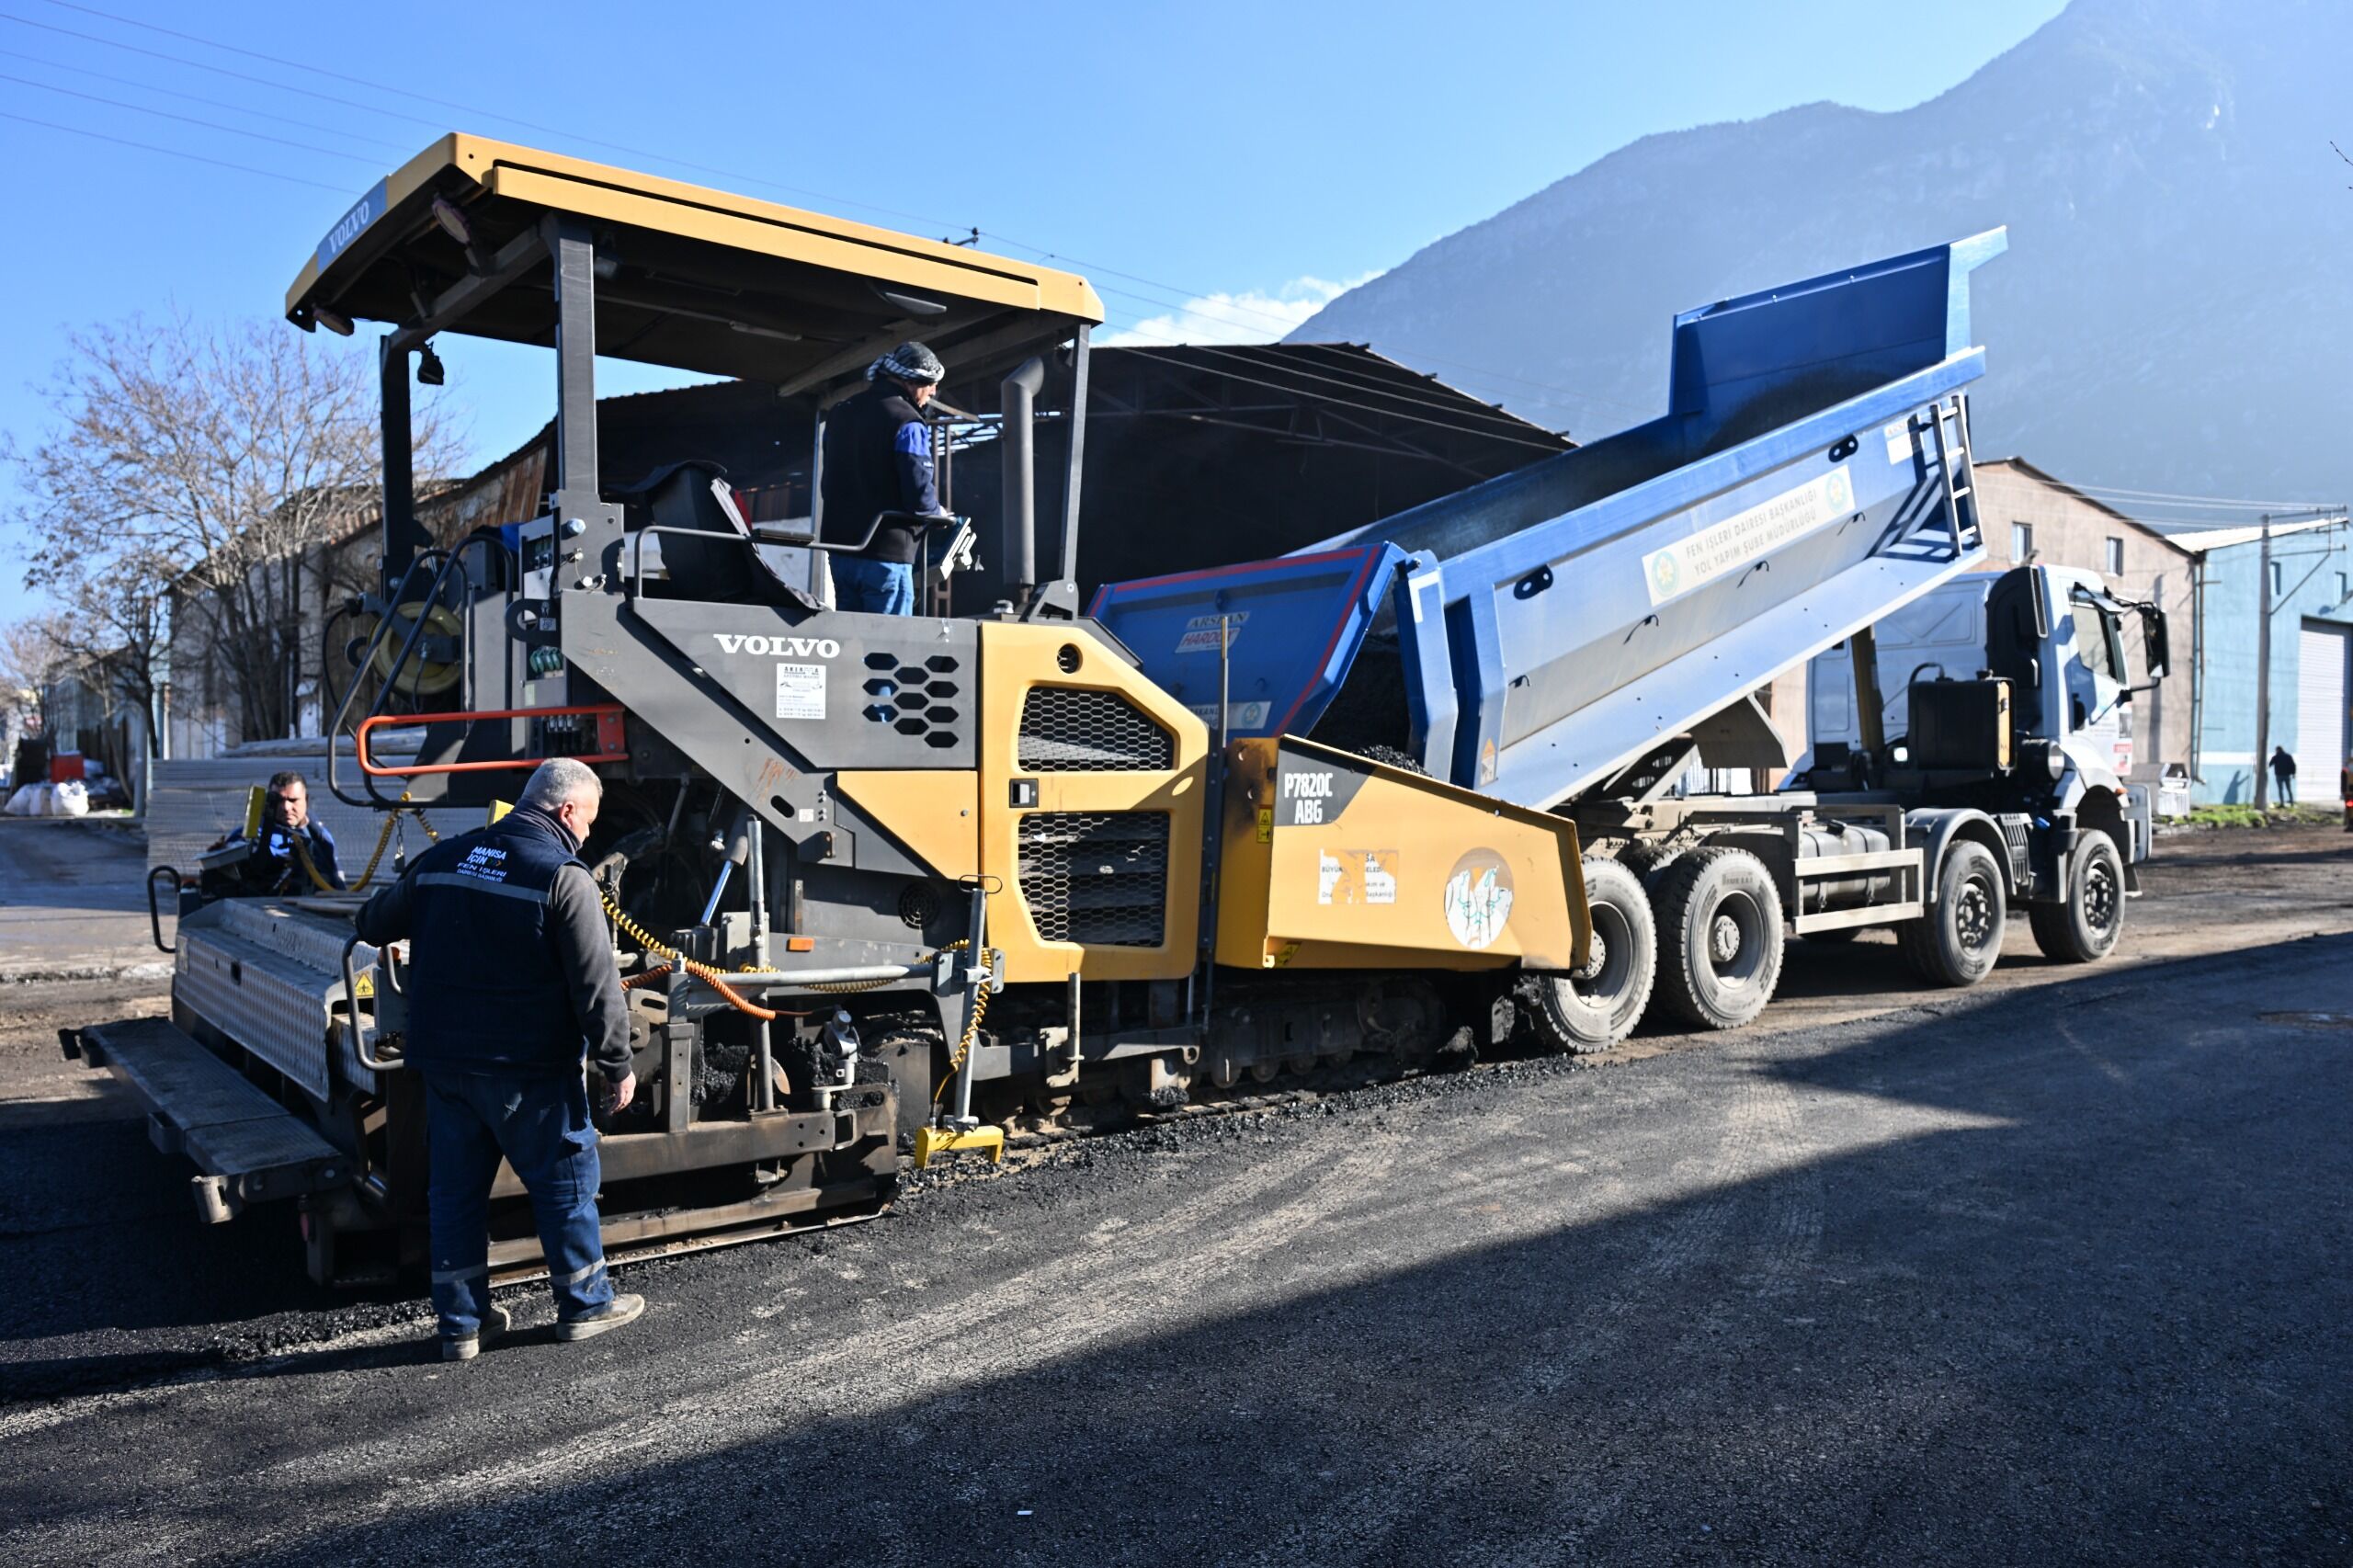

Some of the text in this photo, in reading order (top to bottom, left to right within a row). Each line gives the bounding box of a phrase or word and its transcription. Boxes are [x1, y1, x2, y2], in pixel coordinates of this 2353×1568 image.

[328, 200, 369, 254] VOLVO
[1686, 540, 1703, 559] FEN
[1694, 560, 1712, 576] YOL
[713, 633, 840, 659] VOLVO
[1284, 772, 1333, 798] P7820C
[1294, 799, 1323, 824] ABG
